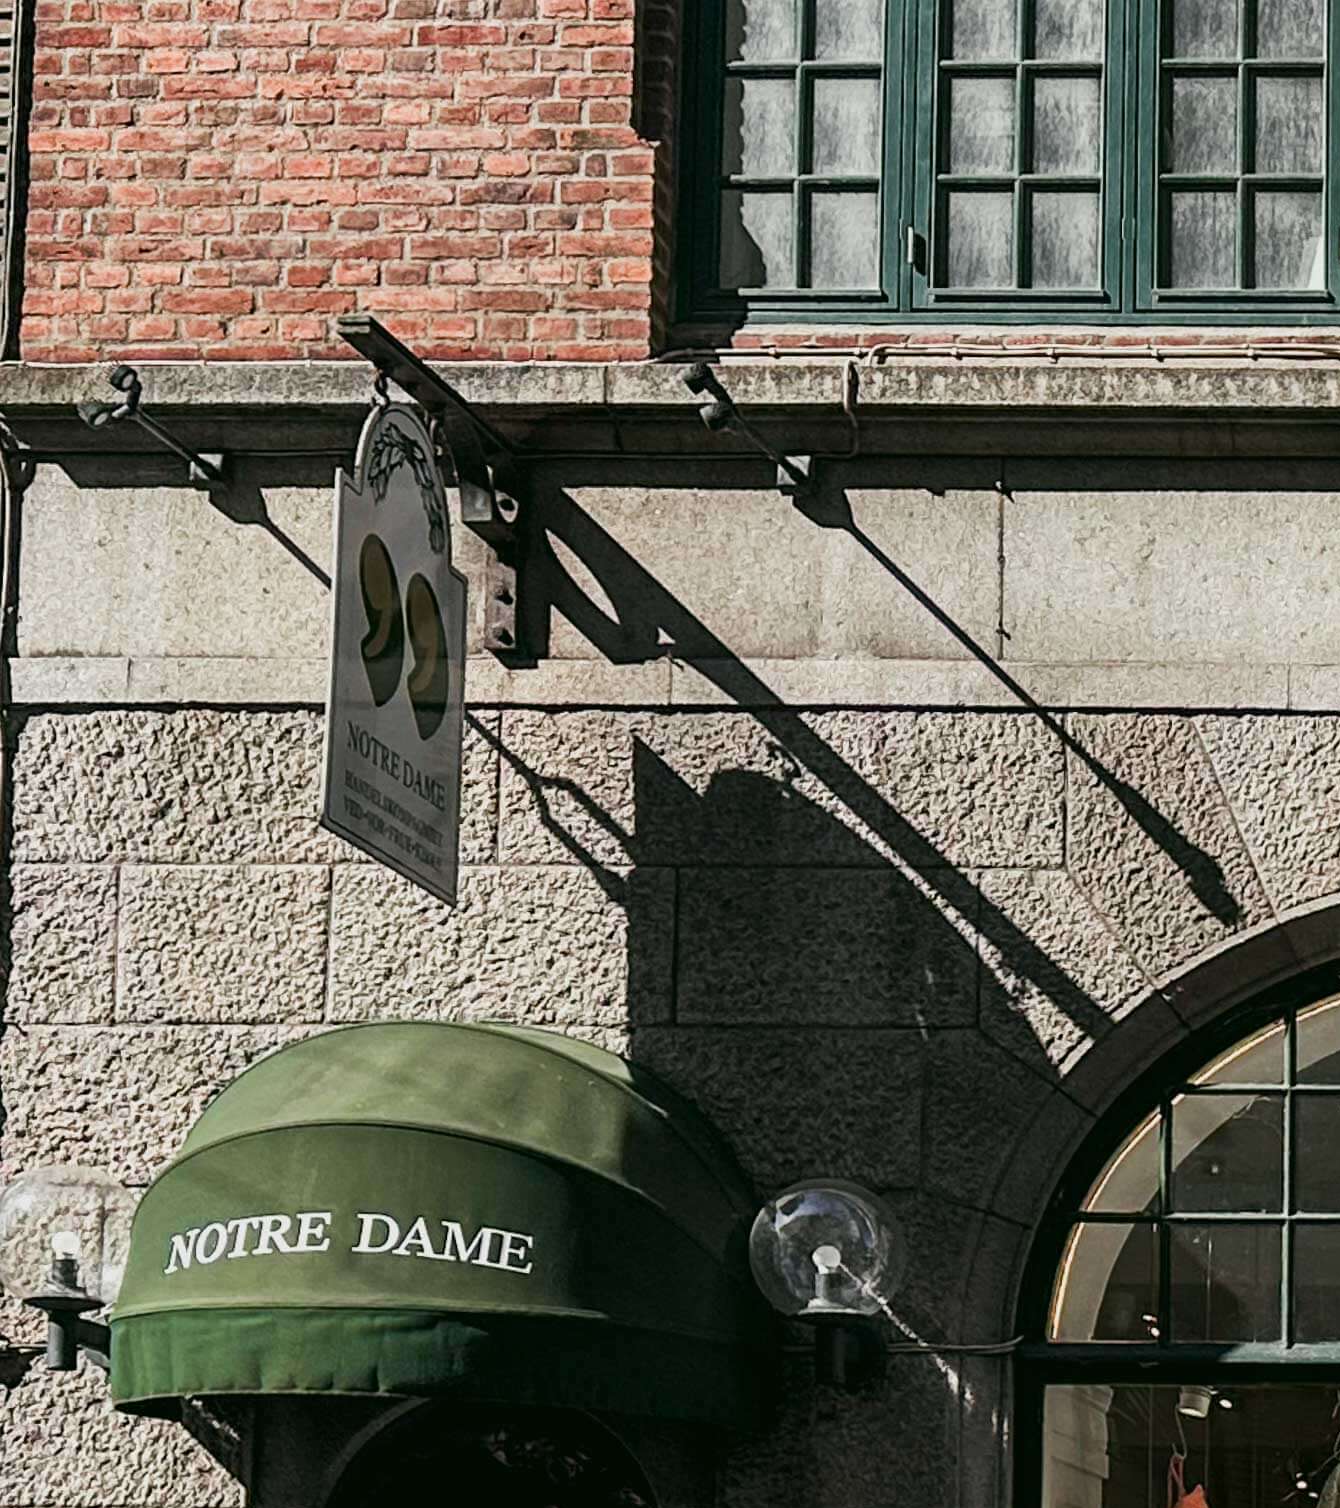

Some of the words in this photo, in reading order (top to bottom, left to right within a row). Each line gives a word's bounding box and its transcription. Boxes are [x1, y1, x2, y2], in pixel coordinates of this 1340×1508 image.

[347, 719, 400, 781] NOTRE
[402, 760, 446, 812] DAME
[164, 1211, 332, 1275] NOTRE
[351, 1212, 534, 1275] DAME
